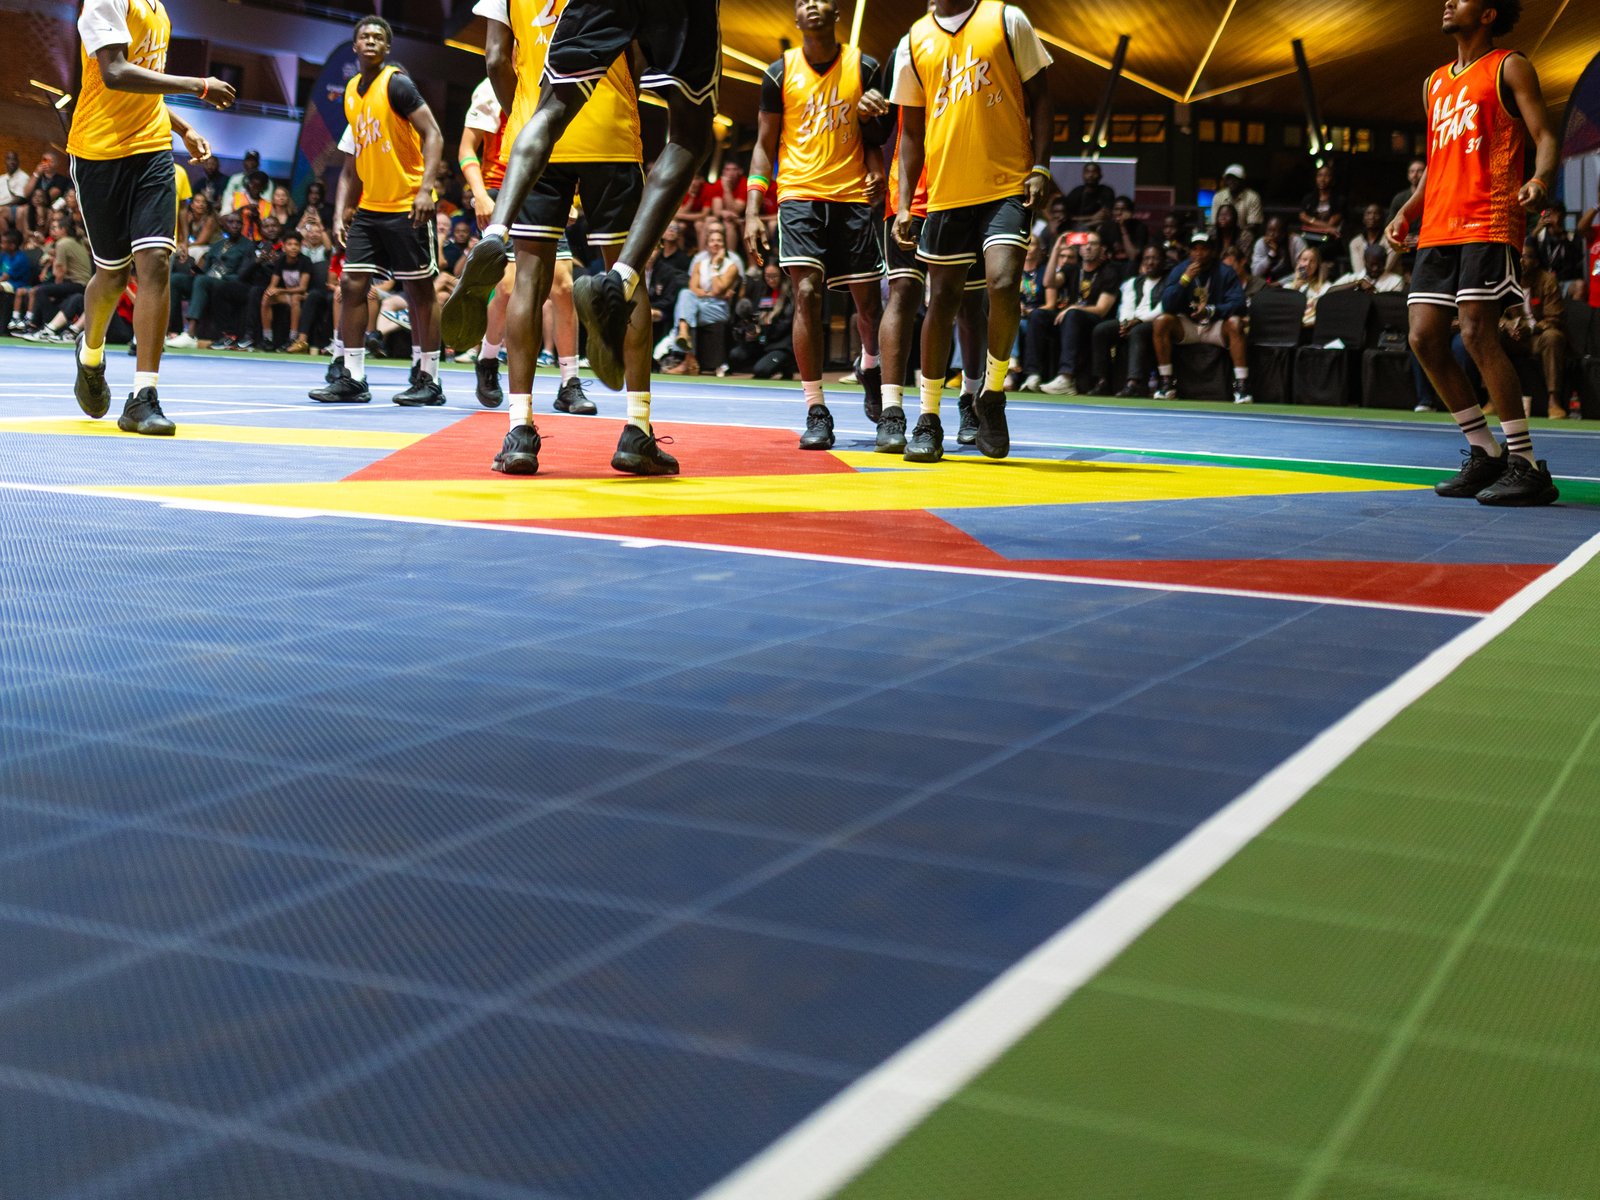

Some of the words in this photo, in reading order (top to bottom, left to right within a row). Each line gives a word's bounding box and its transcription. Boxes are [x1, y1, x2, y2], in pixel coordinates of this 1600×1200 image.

[134, 28, 166, 55] ALL
[942, 44, 980, 83] ALL
[801, 85, 844, 120] ALL
[933, 61, 992, 119] STAR
[987, 90, 1002, 108] 26
[1431, 86, 1471, 131] ALL
[796, 103, 850, 145] STAR
[1432, 103, 1479, 154] TAR
